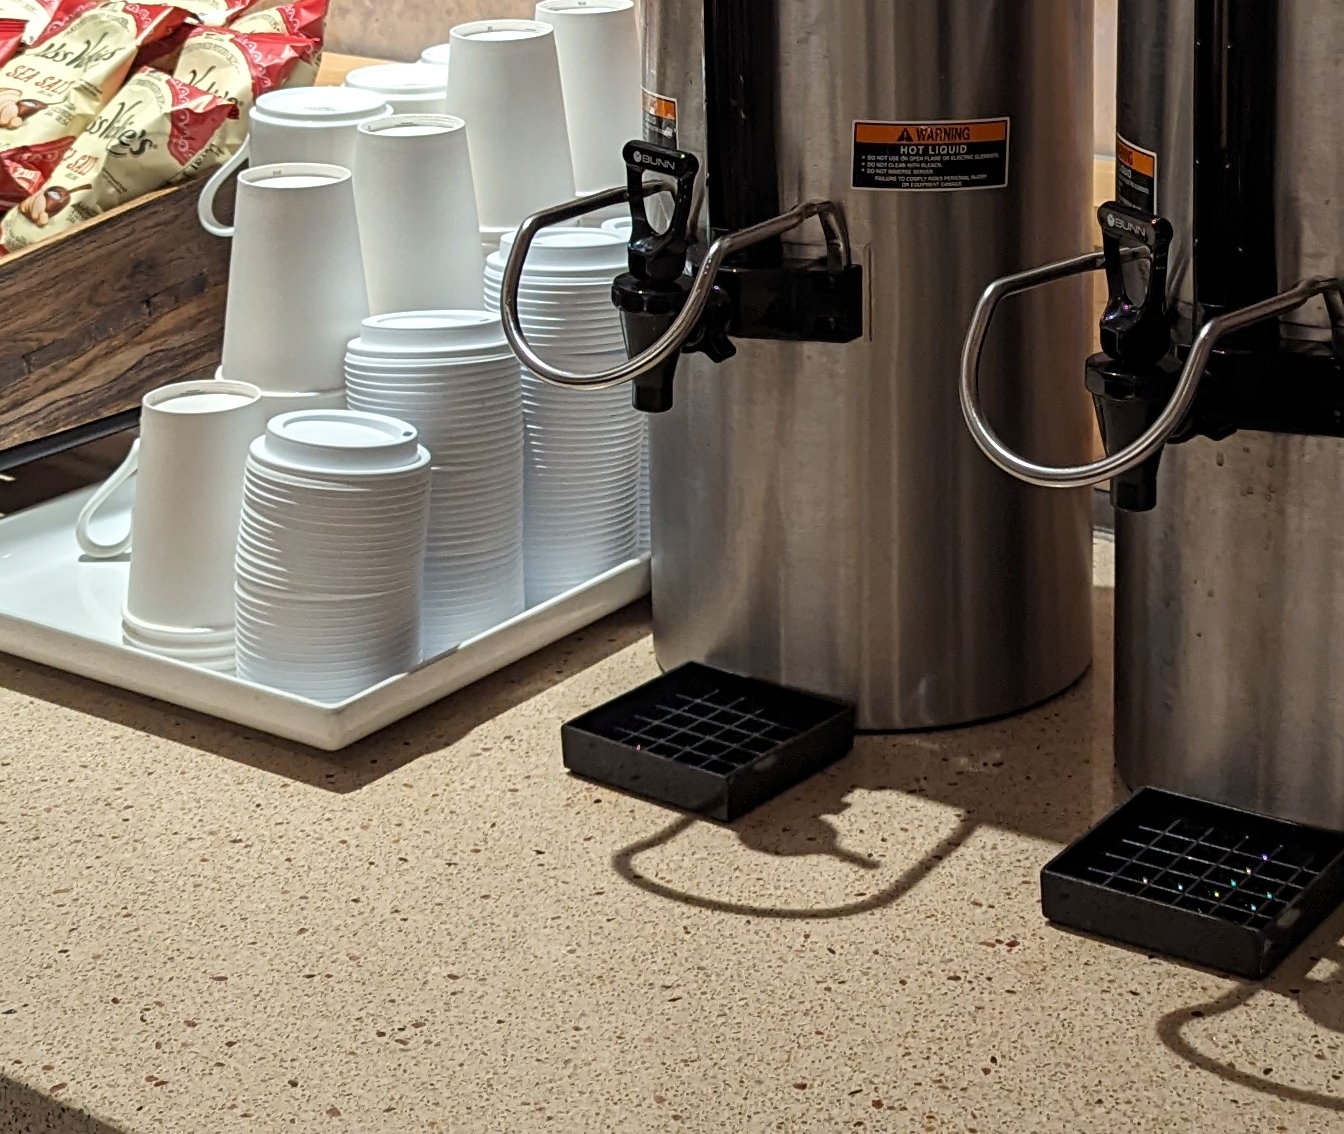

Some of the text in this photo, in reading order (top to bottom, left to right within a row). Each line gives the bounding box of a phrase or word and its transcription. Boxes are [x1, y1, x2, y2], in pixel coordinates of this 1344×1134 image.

[6, 64, 41, 83] SEA
[916, 126, 971, 142] WARNING
[900, 145, 968, 155] HOT LIQUID
[642, 154, 676, 170] BUNN
[1116, 218, 1146, 237] BUNN
